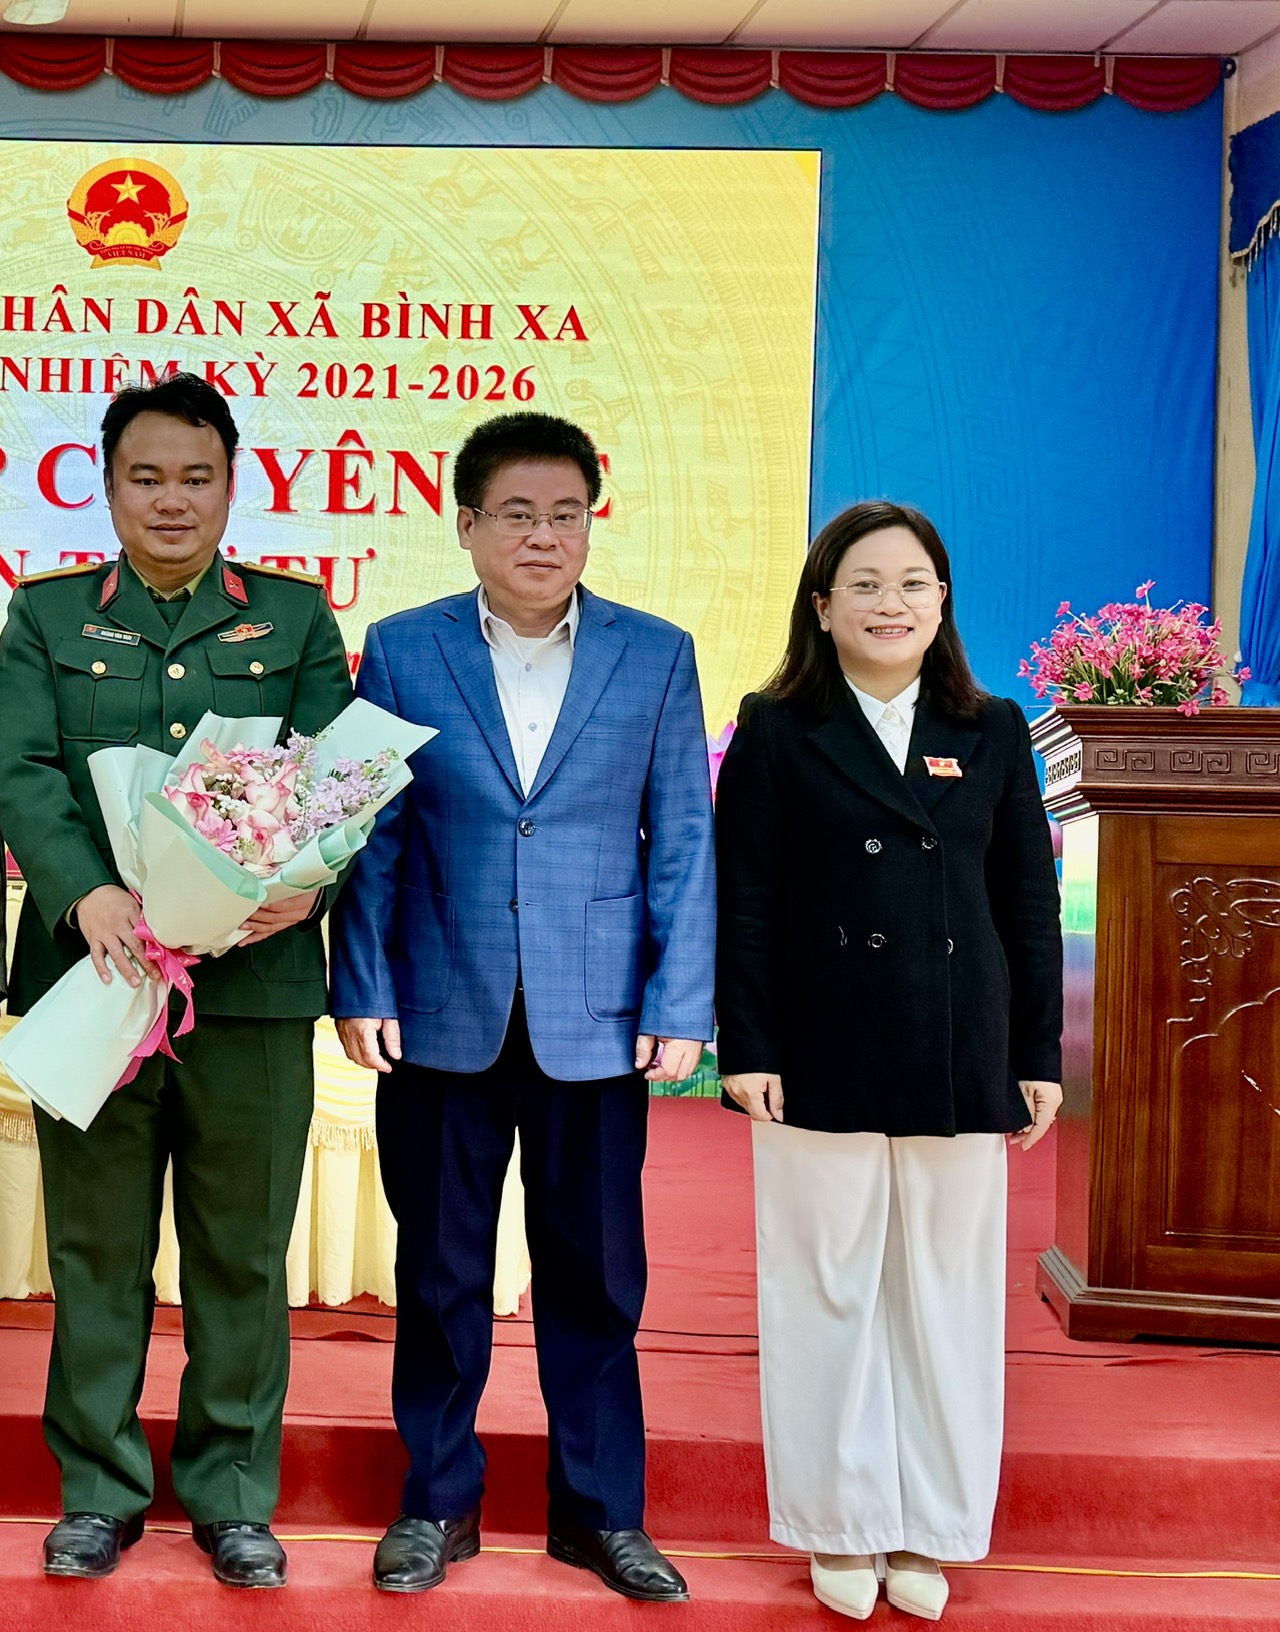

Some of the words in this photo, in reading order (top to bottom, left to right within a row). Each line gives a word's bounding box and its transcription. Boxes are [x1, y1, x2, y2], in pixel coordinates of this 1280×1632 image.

[135, 286, 244, 337] DÂN
[266, 291, 339, 339] XÃ
[360, 291, 494, 341] BÌNH
[515, 303, 589, 342] XA
[203, 351, 278, 398] KỲ
[297, 361, 536, 403] 2021-2026
[36, 428, 451, 519] CYÊN
